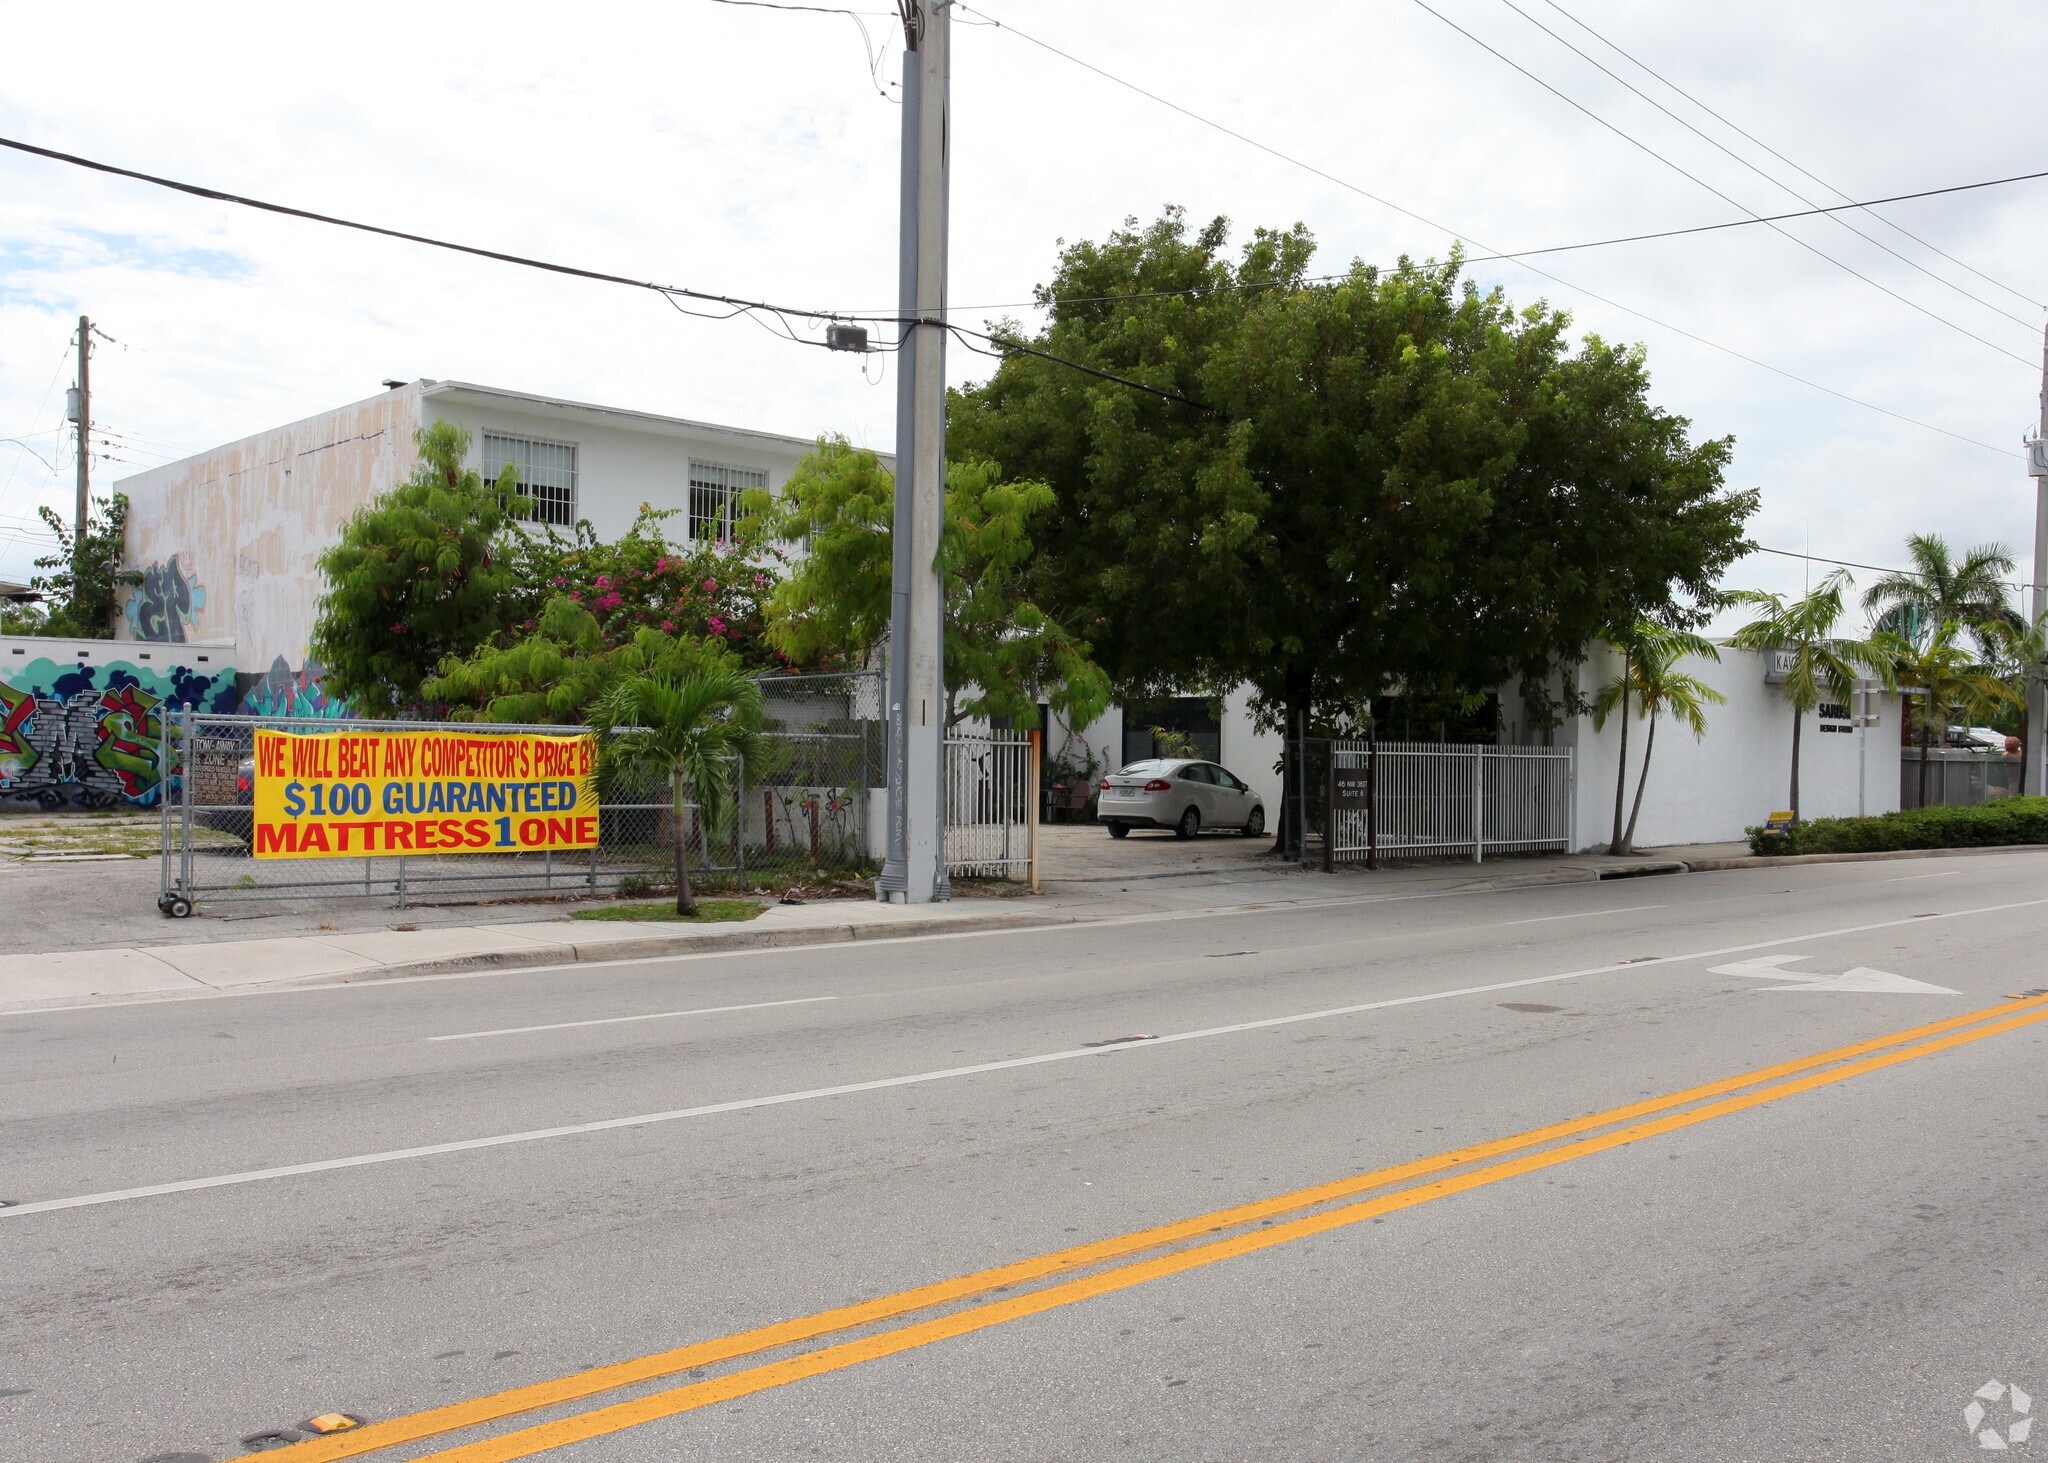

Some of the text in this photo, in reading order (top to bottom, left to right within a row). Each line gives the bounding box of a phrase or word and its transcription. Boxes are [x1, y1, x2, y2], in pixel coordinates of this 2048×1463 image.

[204, 754, 225, 766] ZONE
[258, 736, 286, 777] WE
[293, 737, 332, 779] WILL
[338, 737, 380, 778] BEAT
[384, 738, 419, 777] ANY
[420, 737, 530, 779] COMPETITOR'S
[534, 740, 577, 778] PRICE
[284, 779, 577, 820] $100 GUARANTEED
